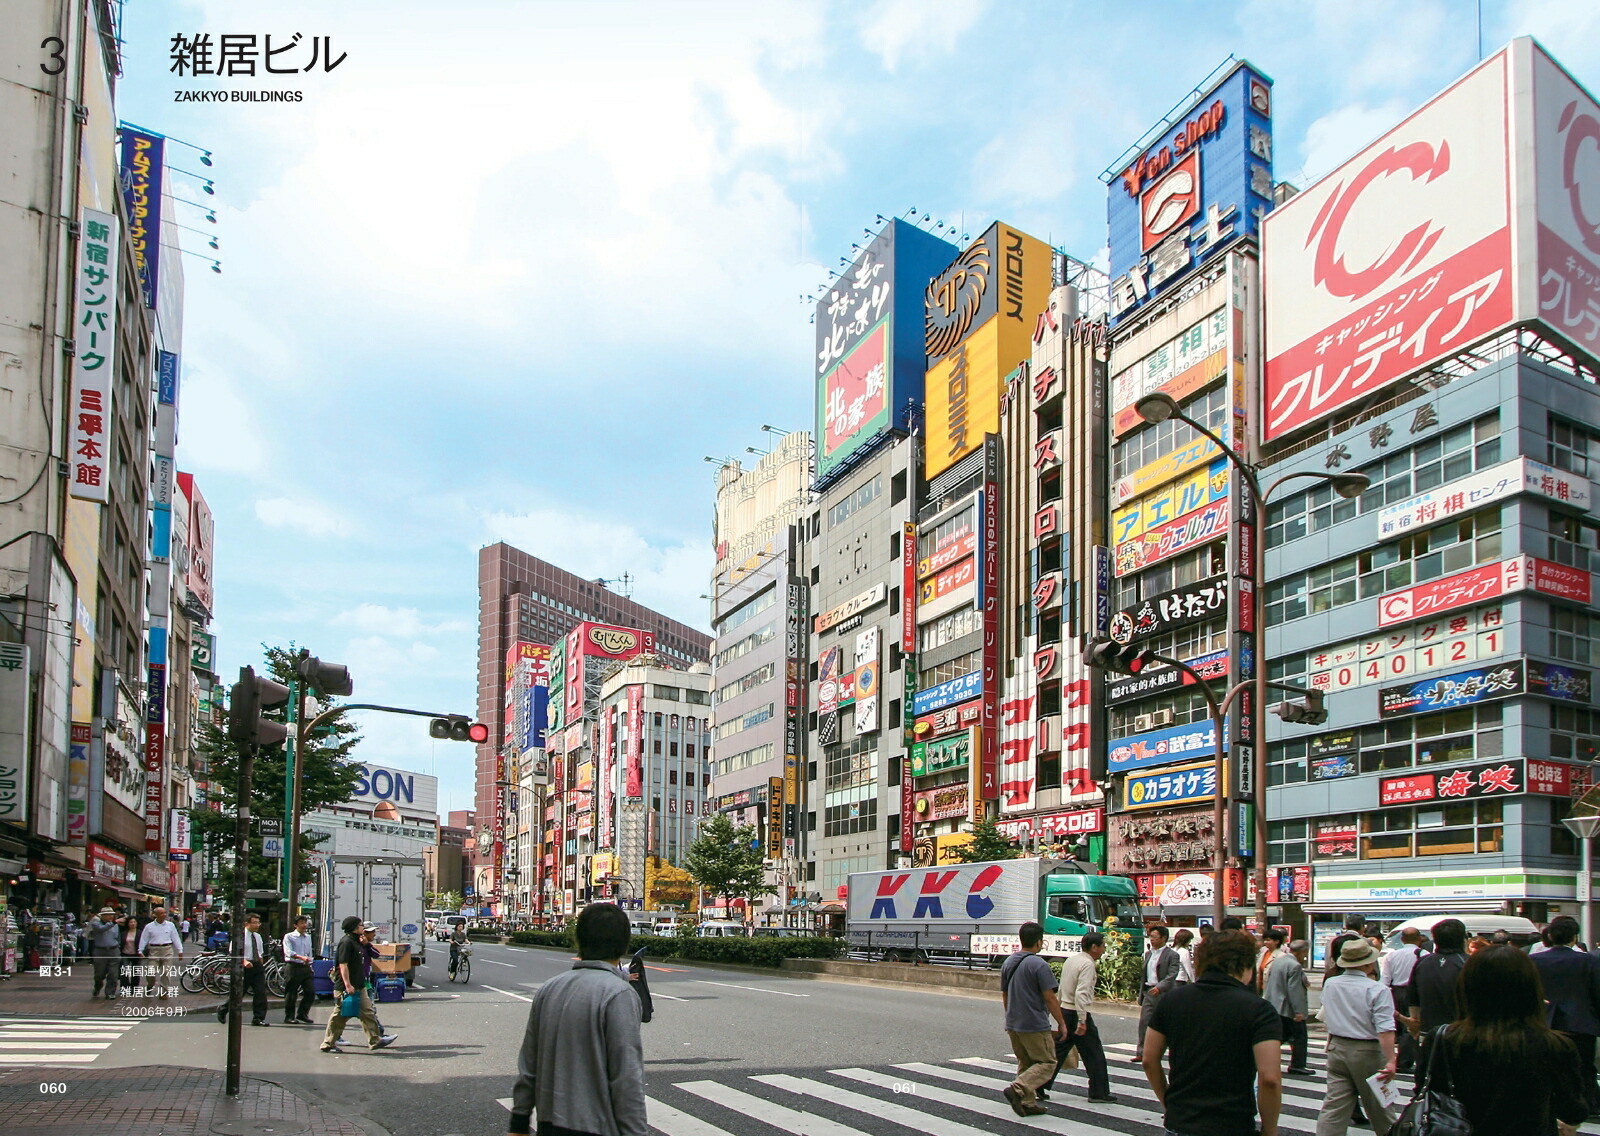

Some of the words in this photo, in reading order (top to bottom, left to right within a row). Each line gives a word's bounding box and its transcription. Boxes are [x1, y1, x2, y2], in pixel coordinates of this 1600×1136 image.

[1174, 100, 1225, 157] shop
[1006, 230, 1024, 324] プロミス
[1111, 203, 1236, 319] 武富士
[82, 221, 111, 372] 新宿サンパーク
[1315, 269, 1444, 355] キャッシング
[1270, 268, 1503, 430] クレディア
[826, 363, 885, 437] 北の家族
[948, 343, 969, 459] プロミス
[76, 389, 103, 488] 三平本館
[1171, 437, 1217, 471] アエル
[1325, 403, 1439, 469] 水野屋
[1382, 477, 1520, 534] 新宿将棋センター
[1525, 474, 1588, 502] 新宿将棋センター
[1033, 302, 1058, 753] パチスロタワー
[1117, 483, 1205, 543] アエル
[905, 539, 914, 568] ディック
[930, 545, 958, 570] ディック
[937, 564, 971, 593] ディック
[1431, 572, 1482, 592] キャッシング
[1541, 565, 1585, 583] 受付カウンター
[820, 589, 878, 627] セラヴィグループ
[1098, 596, 1107, 629] 747
[1159, 580, 1229, 622] はなび
[1240, 592, 1249, 629] クレディア
[1415, 576, 1498, 613] クレディア
[520, 645, 551, 659] パチン
[594, 631, 633, 652] むじんくん
[1314, 609, 1502, 667] キャッシング受付
[0, 645, 23, 671] 三平
[567, 633, 581, 707] アコム
[1337, 632, 1498, 688] 040121
[905, 675, 914, 712] レイク
[939, 678, 963, 698] エイワ
[966, 673, 981, 688] 6F
[985, 597, 995, 788] グリンピース
[1111, 671, 1178, 700] 隠れ家的水族館
[932, 706, 958, 730] 三和
[938, 738, 969, 766] レイク
[1169, 730, 1216, 755] 武富士
[1145, 771, 1201, 801] カラオケ
[1438, 765, 1520, 797] 海峡
[771, 785, 781, 853] ドン・キホーテ
[903, 767, 912, 838] 三和ファイナンス
[869, 864, 1004, 919] KKC
[1369, 887, 1423, 897] FamilyMart
